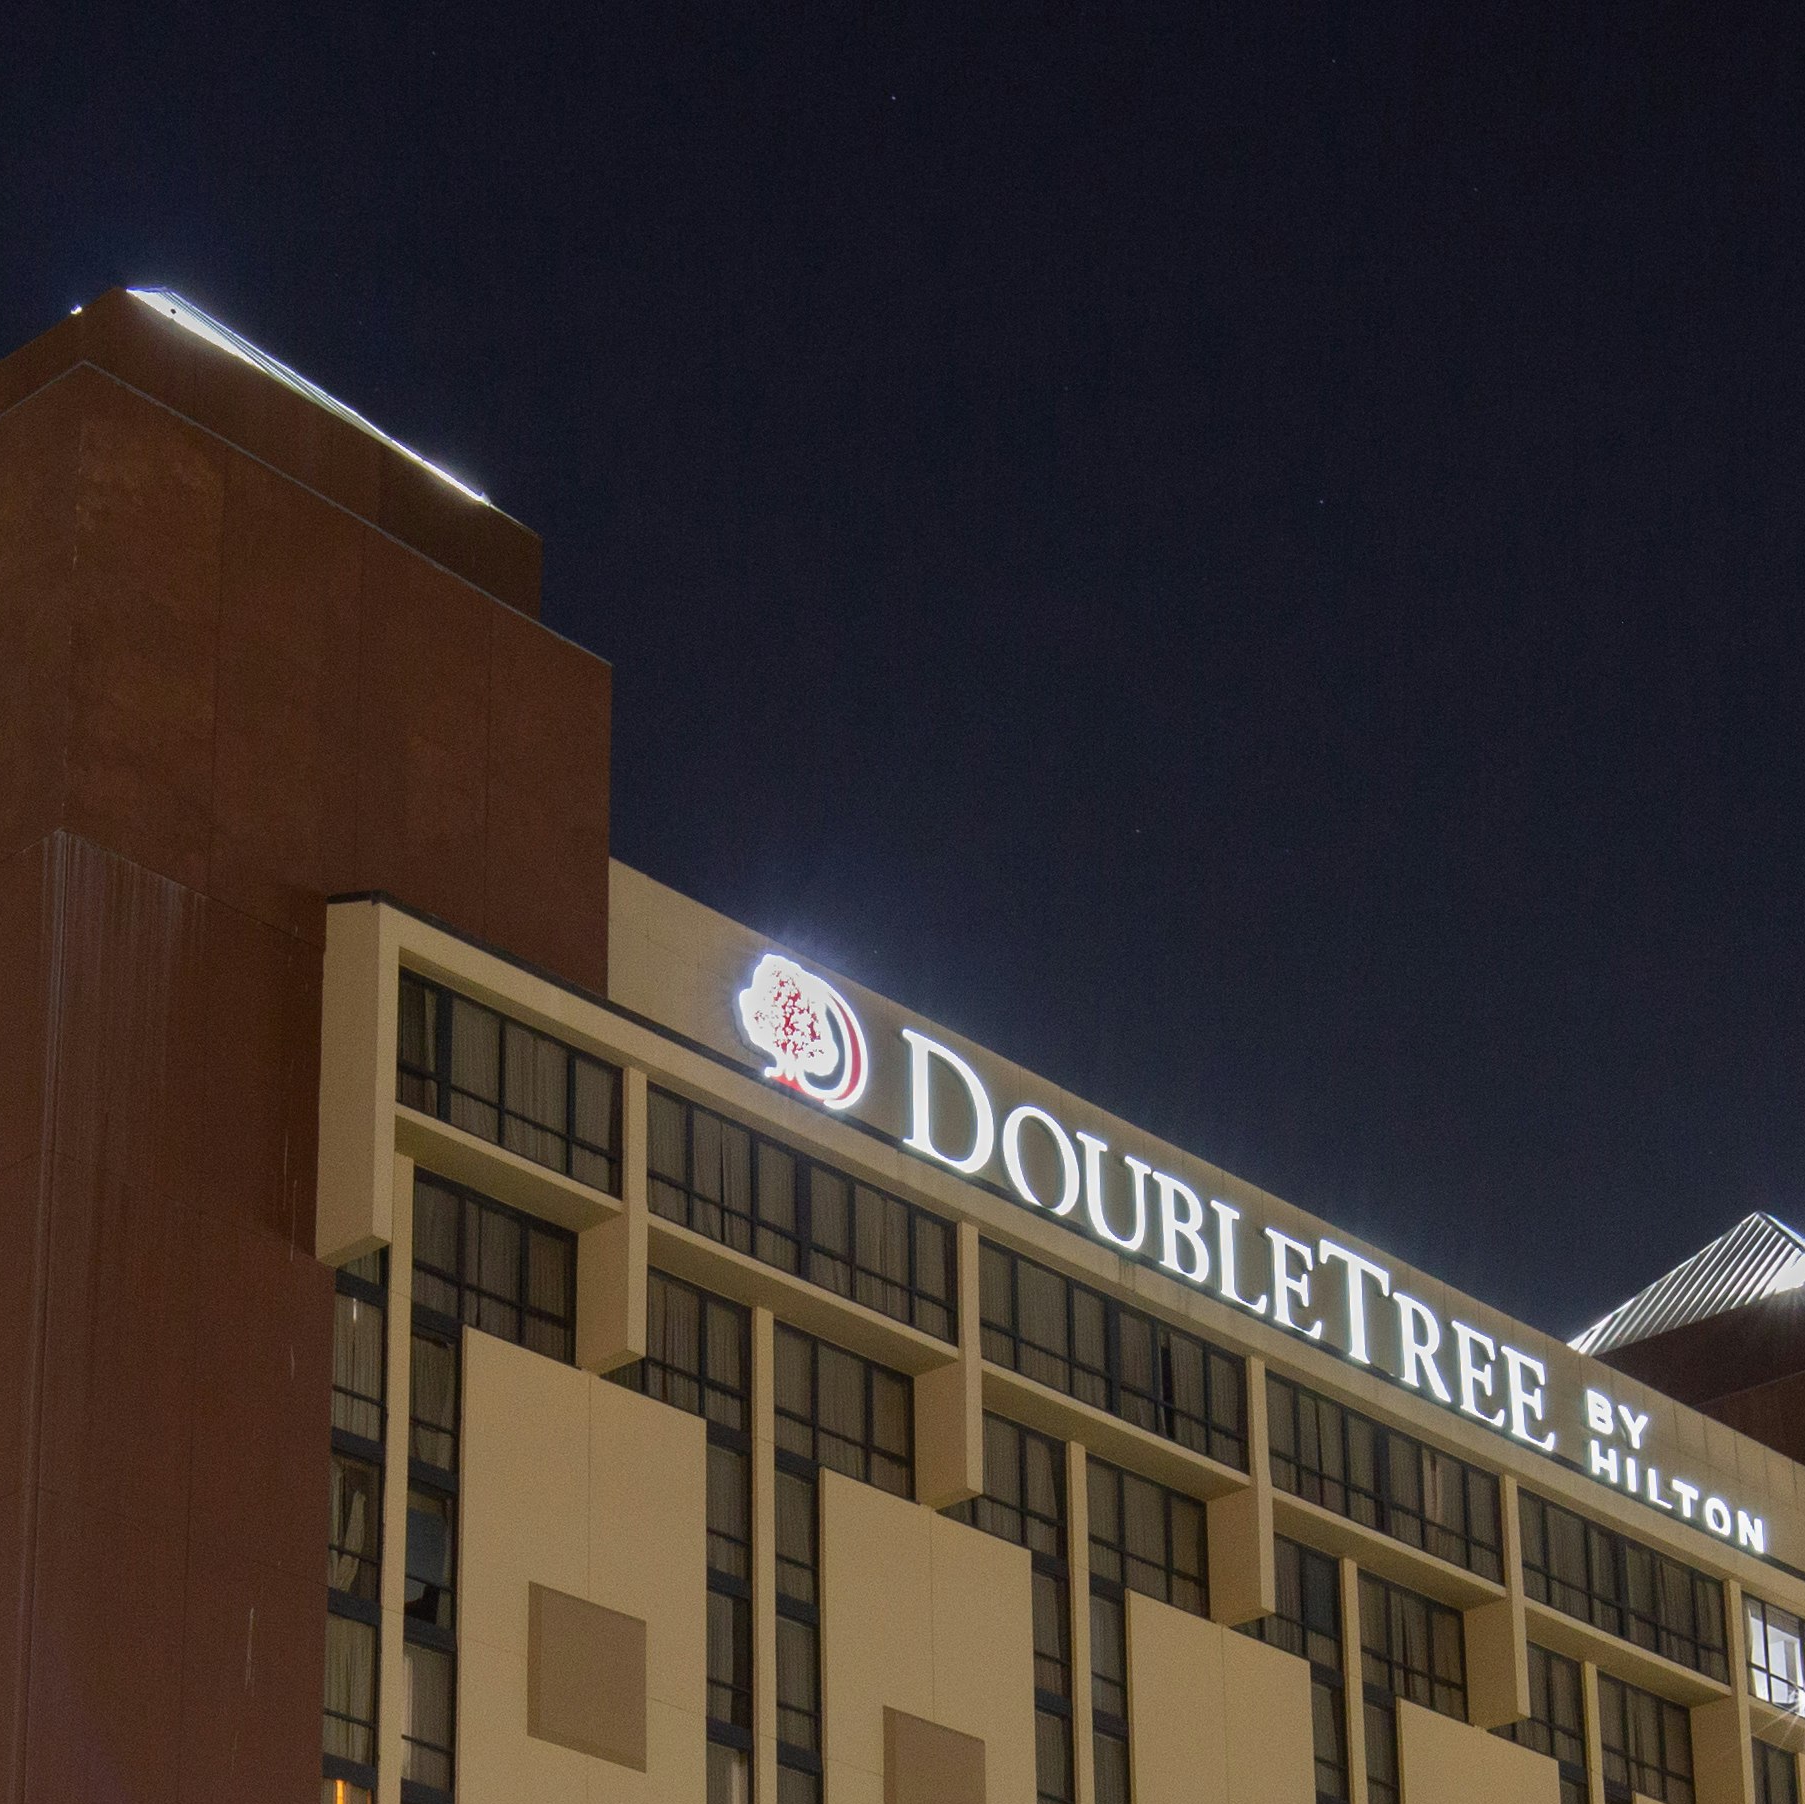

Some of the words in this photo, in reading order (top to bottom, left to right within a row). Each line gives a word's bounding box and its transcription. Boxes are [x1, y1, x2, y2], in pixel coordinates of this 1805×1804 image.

[902, 1028, 1556, 1454] DOUBLETREE
[1585, 1387, 1649, 1450] BY
[1590, 1442, 1764, 1556] HILTON
